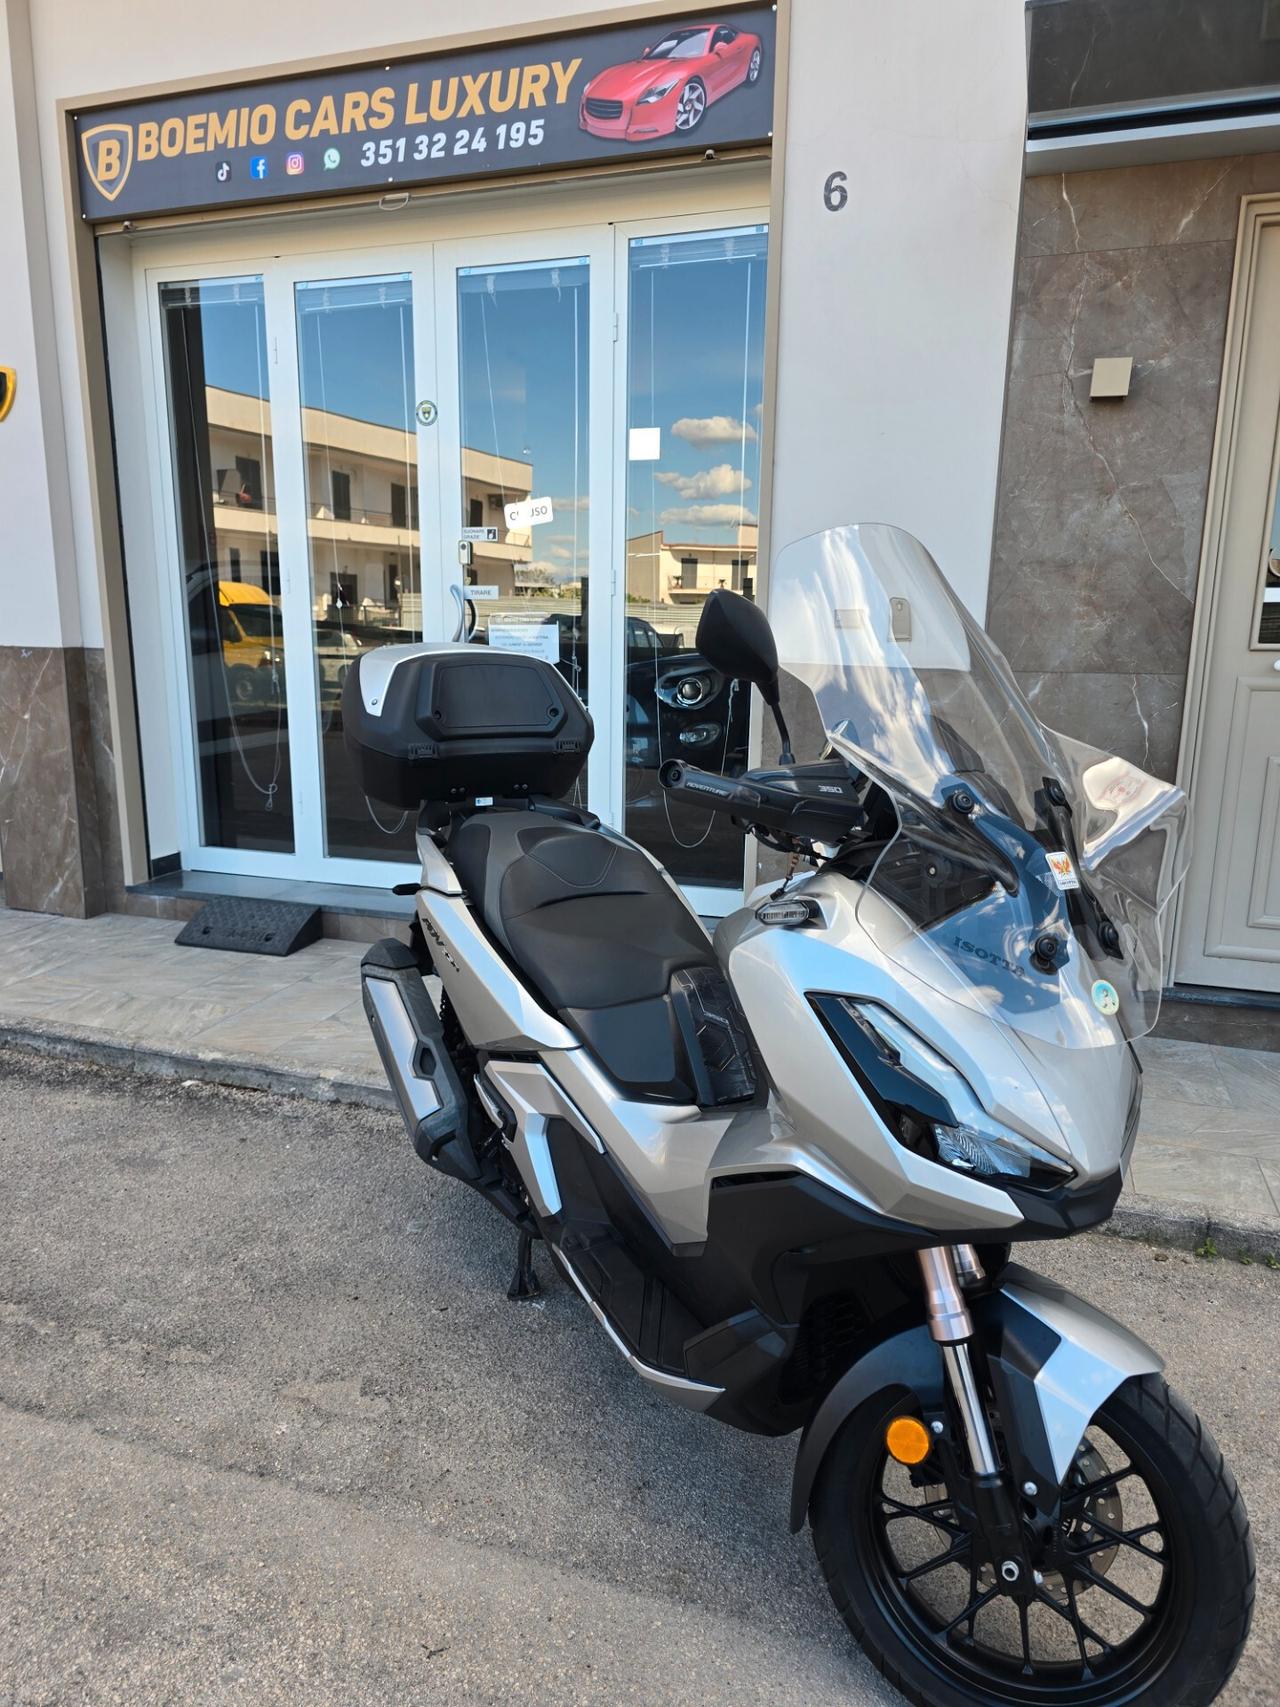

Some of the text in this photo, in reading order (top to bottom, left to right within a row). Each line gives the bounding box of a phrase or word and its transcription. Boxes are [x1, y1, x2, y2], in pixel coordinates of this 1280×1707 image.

[137, 58, 582, 161] BOEMIO CARS LUXURY
[360, 119, 545, 167] 351 32 24 195
[823, 171, 848, 211] 6
[953, 936, 1026, 977] ISOTTA
